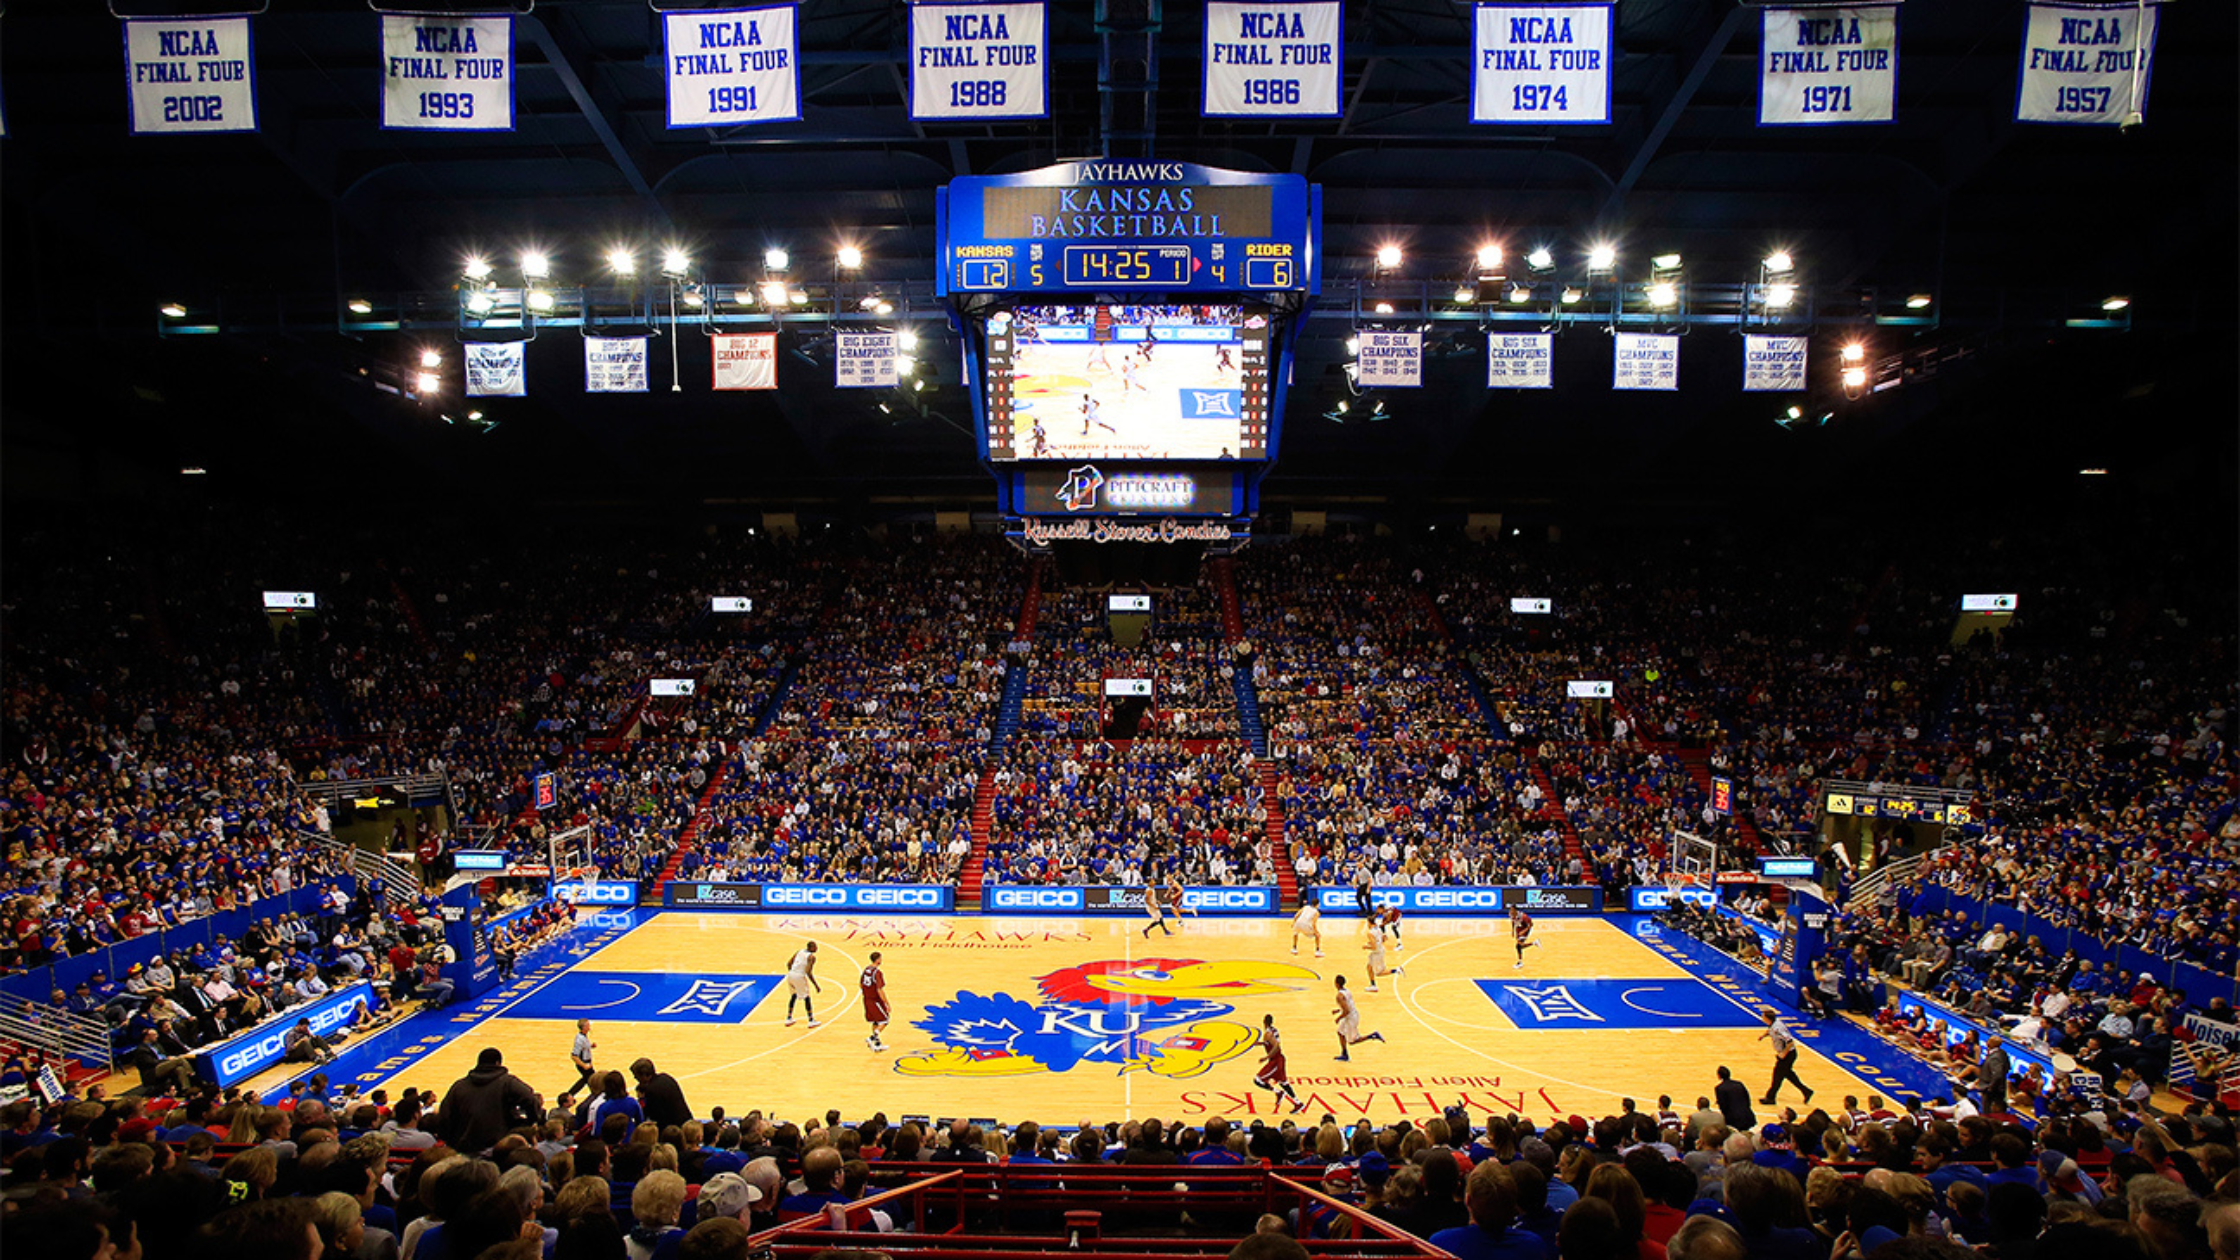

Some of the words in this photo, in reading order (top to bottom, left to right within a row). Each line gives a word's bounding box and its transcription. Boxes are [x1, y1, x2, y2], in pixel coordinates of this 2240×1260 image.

[700, 20, 762, 48] NCAA
[944, 14, 1010, 40] NCAA
[1240, 12, 1305, 40] NCAA
[1508, 18, 1574, 44] NCAA
[1796, 18, 1860, 46] NCAA
[2058, 18, 2122, 46] NCAA
[160, 31, 219, 56] NCAA
[415, 28, 478, 54] NCAA
[674, 51, 733, 76] FINAL
[740, 48, 788, 71] FOUR
[918, 46, 980, 68] FINAL
[986, 44, 1037, 67] FOUR
[1213, 43, 1274, 66] FINAL
[1281, 42, 1332, 65] FOUR
[1482, 49, 1542, 70] FINAL
[1549, 48, 1601, 71] FOUR
[1769, 52, 1830, 74] FINAL
[1836, 50, 1888, 72] FOUR
[2030, 48, 2092, 73] FINAL
[2098, 49, 2146, 71] FOUR
[136, 61, 190, 83] FINAL
[197, 58, 245, 80] FOUR
[390, 57, 448, 78] FINAL
[456, 55, 504, 80] FOUR
[708, 85, 757, 113] 1991
[950, 80, 1006, 107] 1988
[1242, 78, 1300, 106] 1986
[1512, 84, 1568, 112] 1974
[1802, 86, 1852, 114] 1971
[2056, 86, 2112, 114] 1957
[164, 96, 222, 122] 2002
[418, 93, 474, 118] 1993
[1074, 163, 1184, 184] JAYHAWKS
[1060, 188, 1194, 213] KANSAS
[1031, 214, 1227, 237] BASKETBALL
[956, 246, 1014, 258] KANSAS
[1160, 249, 1187, 258] PERIOD
[1246, 244, 1292, 257] RIDER
[983, 264, 1003, 286] 12
[1030, 264, 1043, 286] 5
[1082, 251, 1150, 279] 14:25
[1174, 260, 1180, 280] 1
[1211, 265, 1225, 282] 4
[1273, 262, 1287, 286] 6
[840, 347, 895, 358] CHAMPIONS
[843, 337, 860, 346] BIG
[862, 336, 891, 346] EIGHT
[1362, 347, 1418, 358] CHAMPIONS
[1372, 336, 1390, 346] BIG
[1392, 336, 1409, 346] SIX
[1503, 337, 1519, 347] BIG
[1522, 337, 1538, 347] SIX
[590, 352, 643, 364] CHAMPIONS
[717, 350, 772, 360] CHAMPIONS
[1492, 348, 1547, 358] CHAMPIONS
[1619, 350, 1674, 360] CHAMPIONS
[1750, 352, 1804, 362] CHAMPIONS
[1021, 517, 1092, 544] Russell
[1093, 518, 1160, 543] Stover
[1160, 518, 1232, 542] Candies
[766, 888, 847, 903] GEICO
[857, 889, 937, 905] GEICO
[996, 890, 1078, 906] GEICO
[1182, 892, 1264, 906] GEICO
[1323, 892, 1404, 906] GECO
[1415, 892, 1496, 906] GEICO
[843, 930, 1093, 942] JAYHAWKS
[920, 941, 1032, 949] Fieldhouse
[1035, 1011, 1143, 1035] KU
[1287, 1075, 1424, 1089] Fieldhous
[1435, 1075, 1501, 1088] Allen
[1835, 1051, 1923, 1099] Cour
[1180, 1086, 1562, 1116] JAYHAWKS
